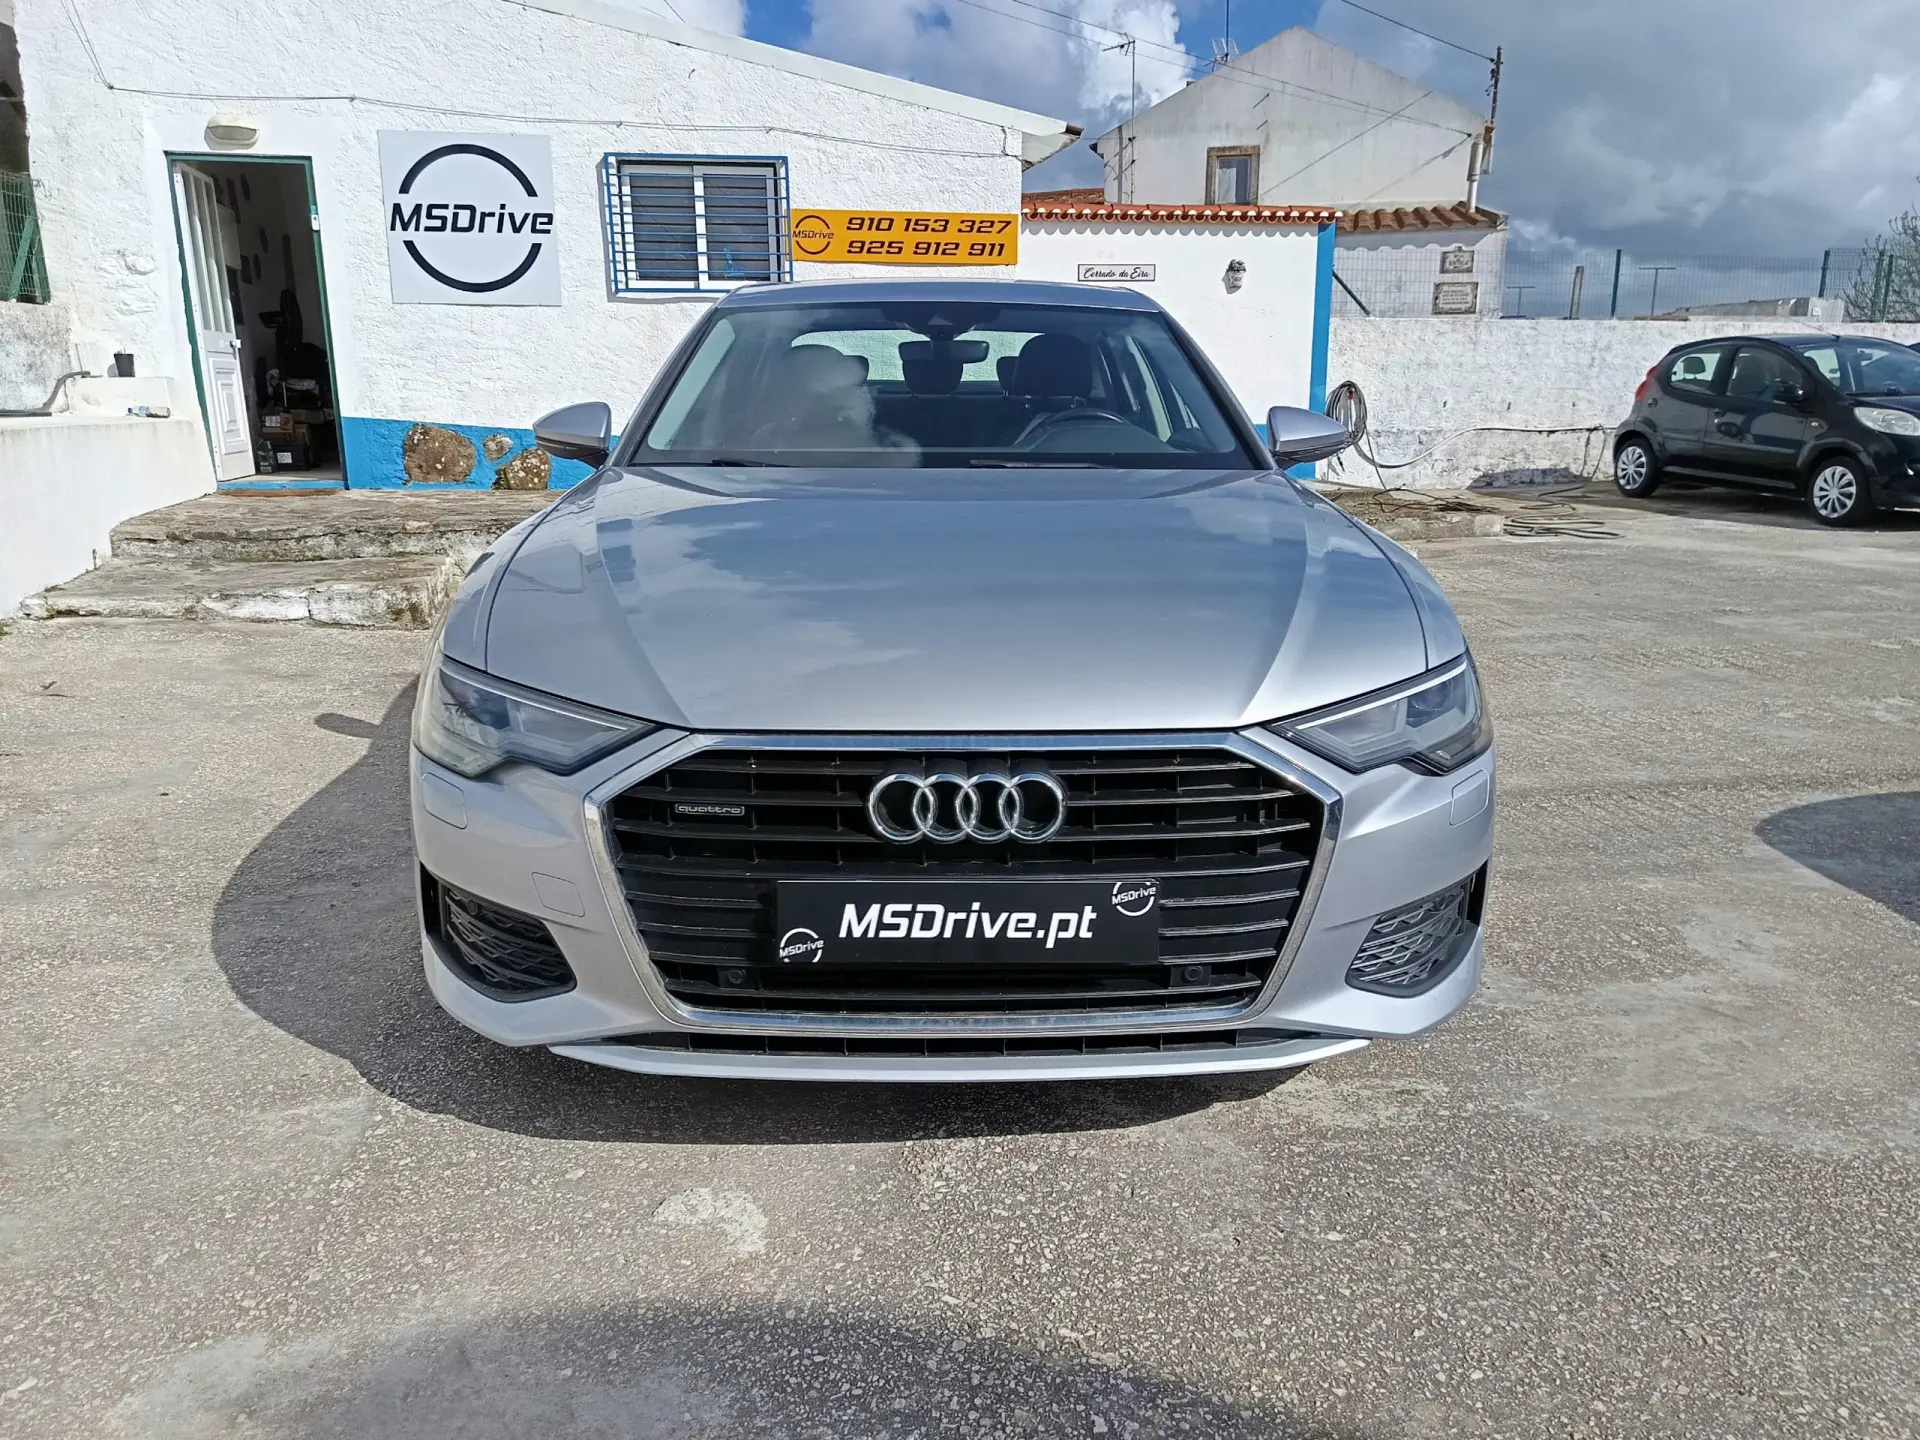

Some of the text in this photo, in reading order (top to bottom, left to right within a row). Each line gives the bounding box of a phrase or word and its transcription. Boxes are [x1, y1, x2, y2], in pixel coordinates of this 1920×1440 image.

[390, 203, 554, 234] MSDrive
[846, 217, 1012, 234] 910 153 327
[793, 230, 834, 239] MSDrive
[847, 240, 1006, 257] 925 912 911
[1118, 269, 1128, 278] da
[678, 805, 742, 814] quattro
[1111, 886, 1157, 905] MSDrive
[838, 901, 1098, 949] MSDrive.pt
[779, 939, 825, 958] MSDrive
